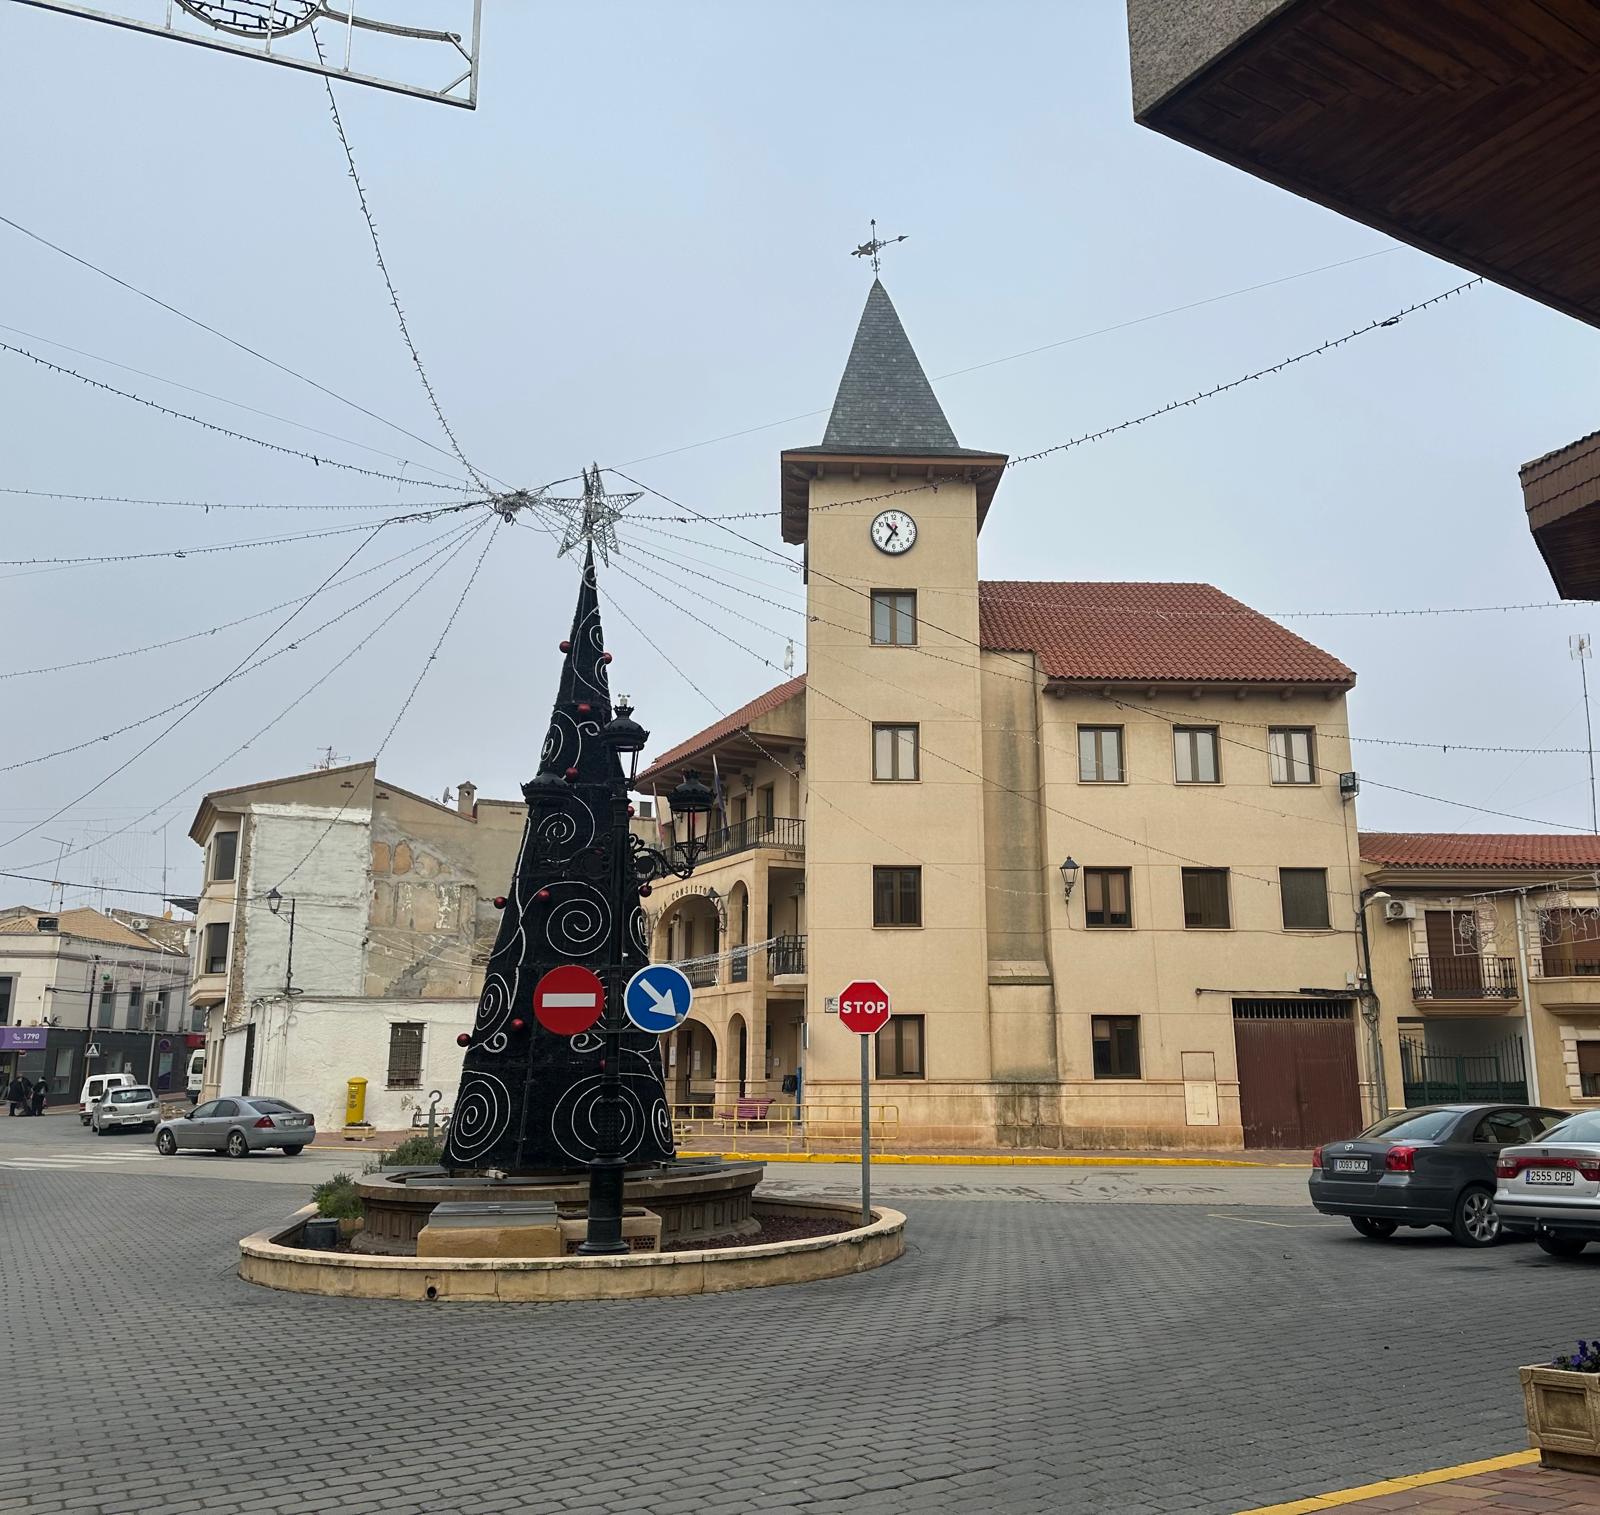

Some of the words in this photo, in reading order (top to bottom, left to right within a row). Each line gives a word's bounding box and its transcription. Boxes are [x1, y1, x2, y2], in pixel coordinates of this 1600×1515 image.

[842, 1001, 886, 1014] STOP
[1339, 1160, 1352, 1169] 0093
[1354, 1160, 1366, 1170] CKZ
[1531, 1171, 1552, 1181] 2555
[1554, 1172, 1572, 1182] CPB
